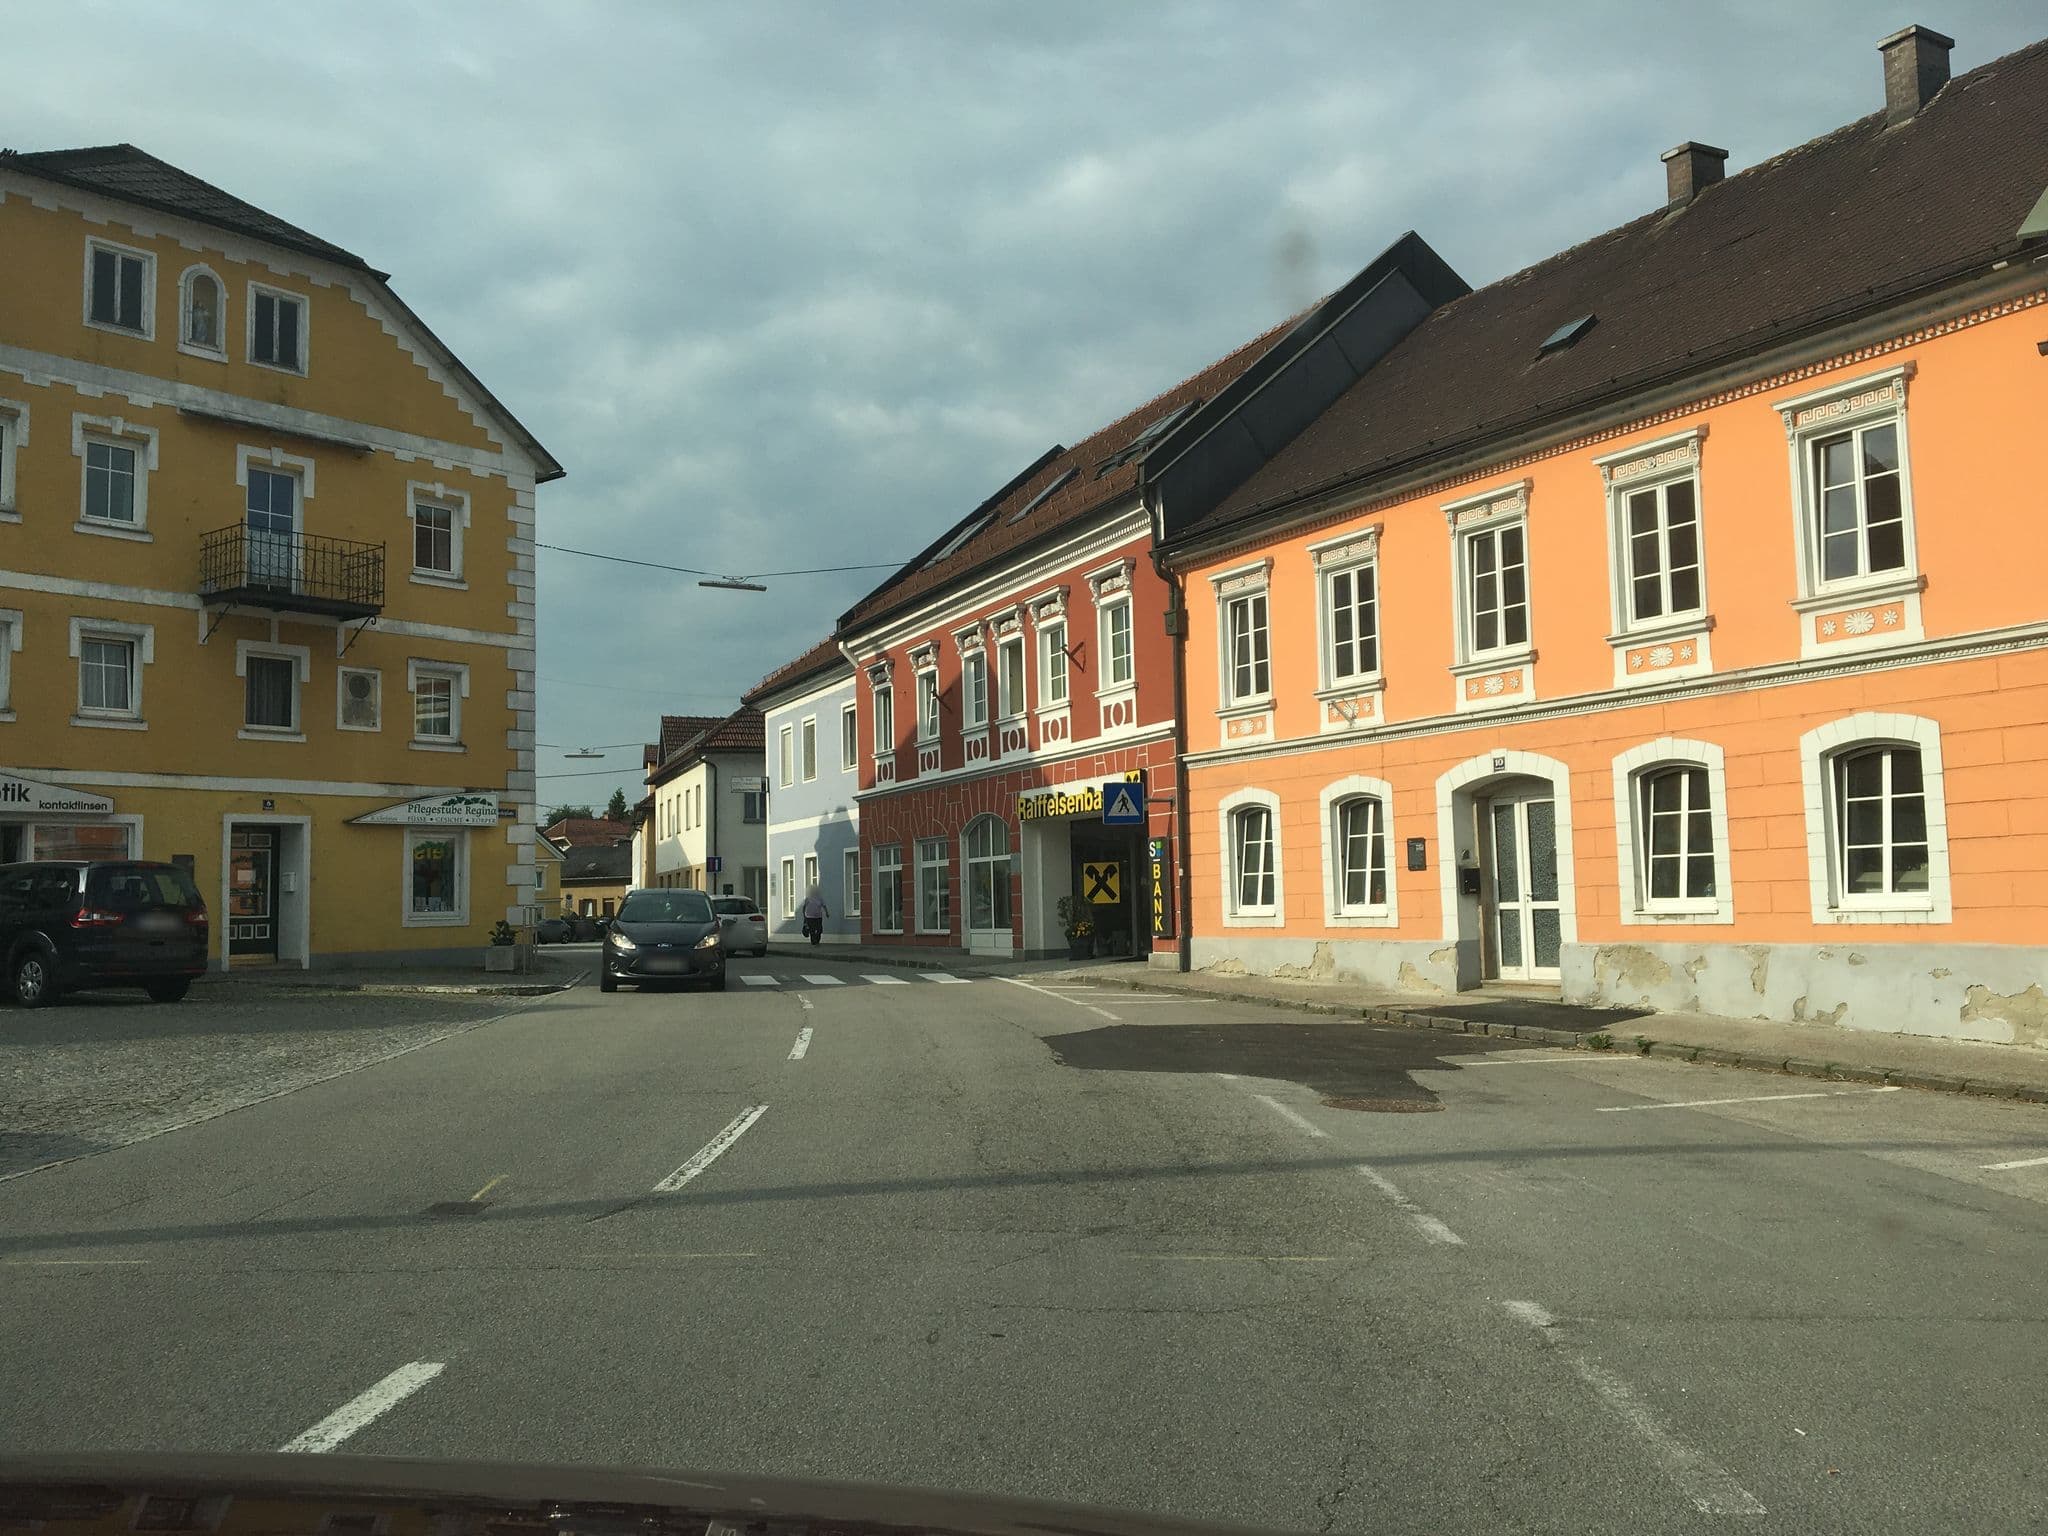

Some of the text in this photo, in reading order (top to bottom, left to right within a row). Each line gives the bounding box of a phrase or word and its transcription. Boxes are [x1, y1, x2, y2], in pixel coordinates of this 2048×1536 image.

[1494, 758, 1504, 767] 10
[0, 783, 31, 802] tik
[39, 800, 108, 811] kontaktlinsen
[407, 804, 462, 816] Pflegestube
[465, 806, 497, 817] Regina
[1018, 787, 1103, 821] Raiffeisenba
[1152, 863, 1163, 932] BANK
